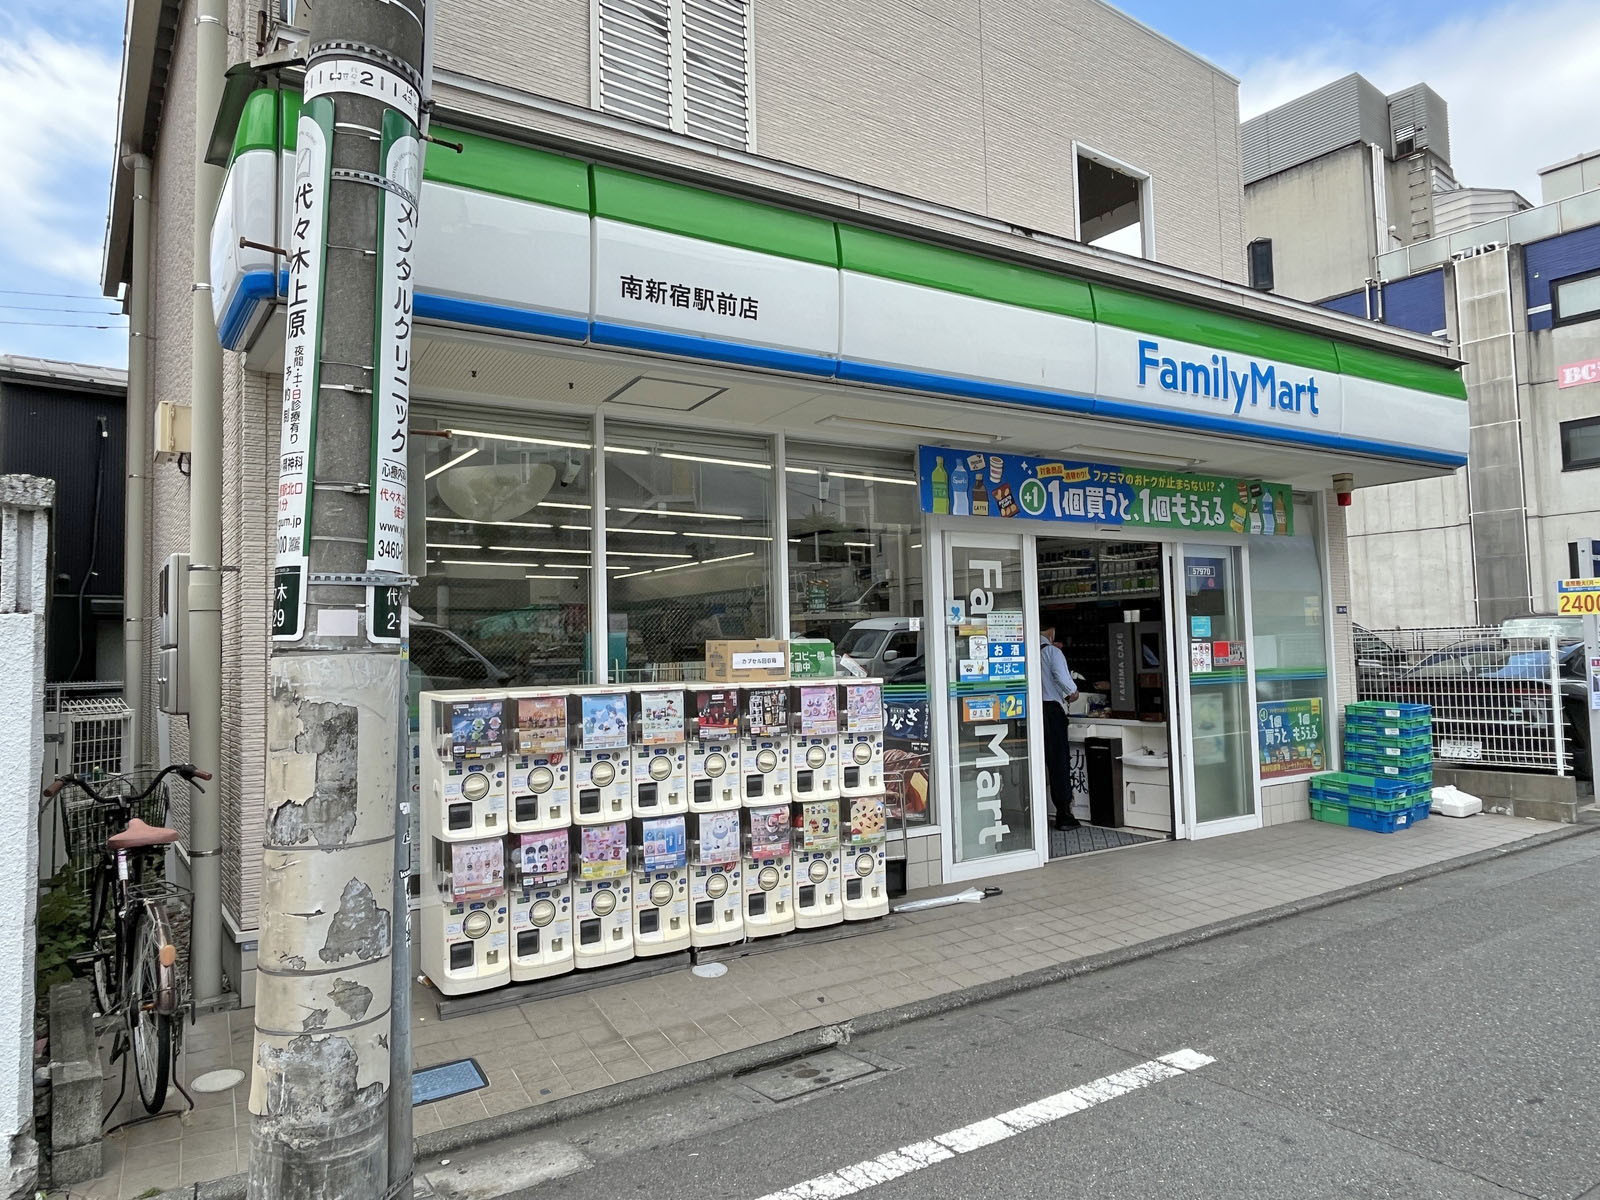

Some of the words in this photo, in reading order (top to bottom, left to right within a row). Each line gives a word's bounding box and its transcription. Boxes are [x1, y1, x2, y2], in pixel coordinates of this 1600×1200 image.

[287, 182, 313, 339] 代々木上原
[391, 202, 413, 453] メンタルクリニック
[620, 274, 759, 321] 南新宿駅前店
[1138, 339, 1319, 415] FamilyMart
[1562, 361, 1600, 385] BC
[1093, 469, 1216, 492] ファミマのおトクが止まらない!?
[994, 662, 1020, 674] たばこ
[974, 723, 1011, 845] Mart
